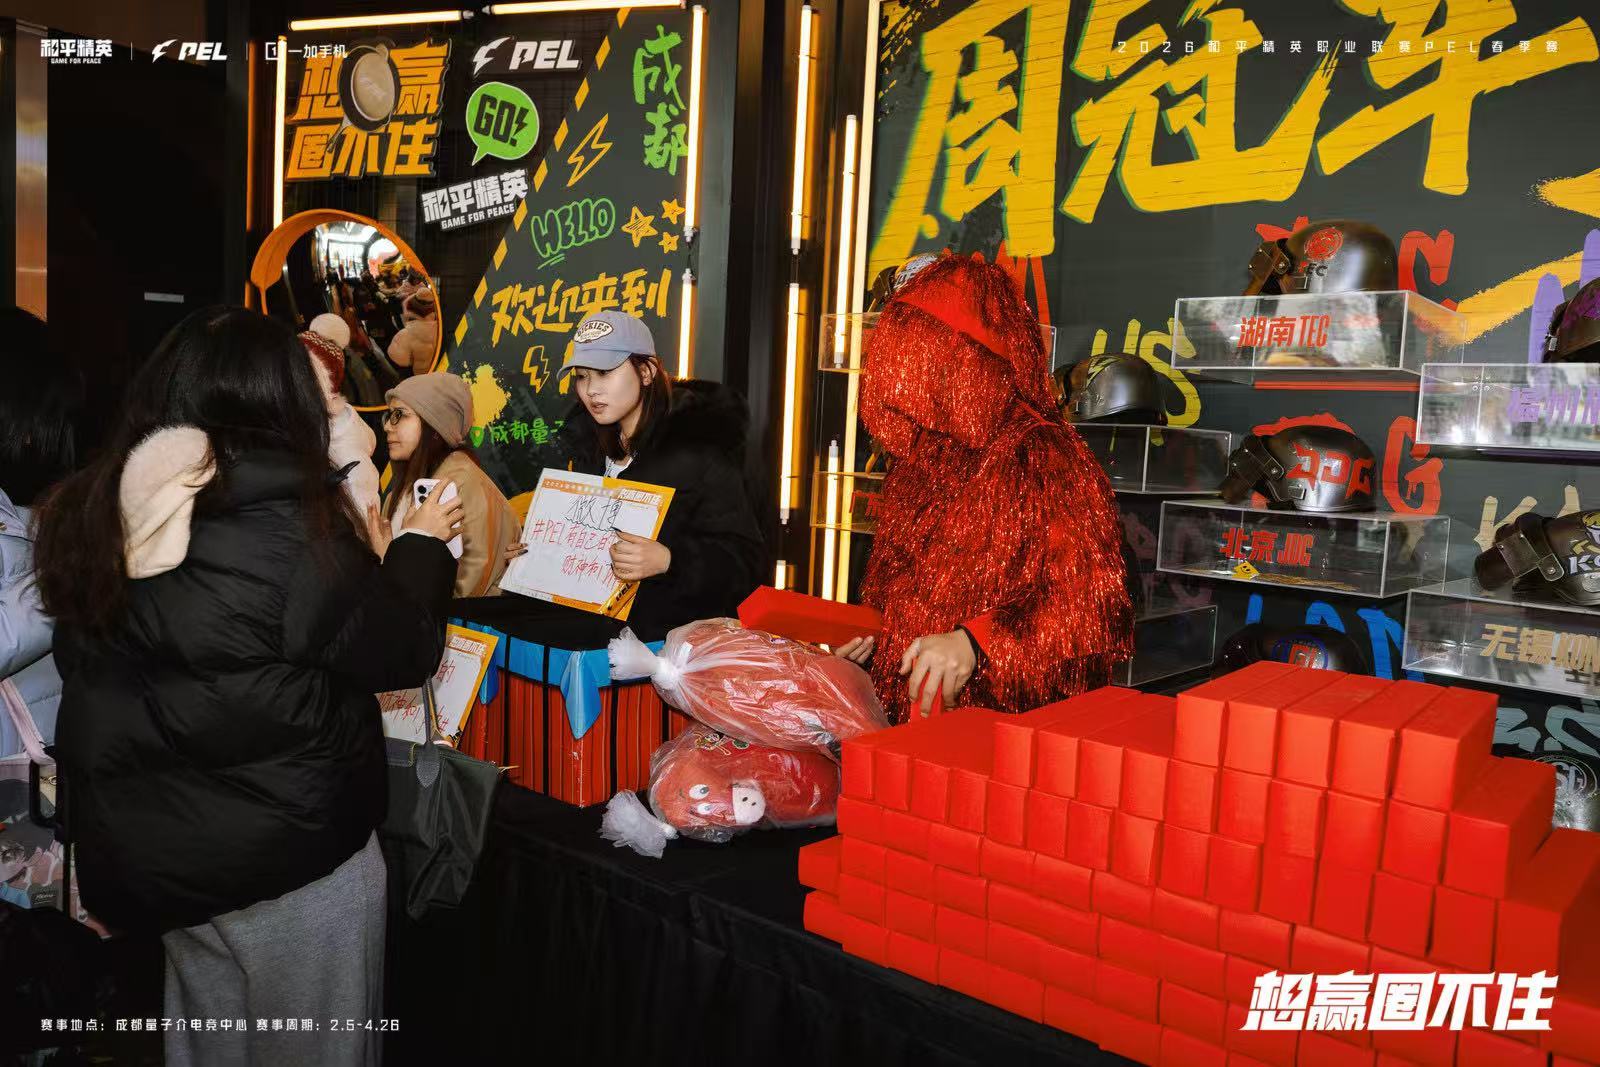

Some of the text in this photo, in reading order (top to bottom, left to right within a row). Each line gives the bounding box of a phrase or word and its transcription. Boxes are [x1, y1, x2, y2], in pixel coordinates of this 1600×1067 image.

[509, 40, 580, 70] PEL
[474, 93, 529, 147] GO!
[632, 24, 690, 176] 成都
[422, 169, 528, 222] 和平精英
[441, 204, 515, 230] GAME FOR PEACE
[531, 198, 616, 258] HELLO
[491, 268, 672, 348] 欢迎来到
